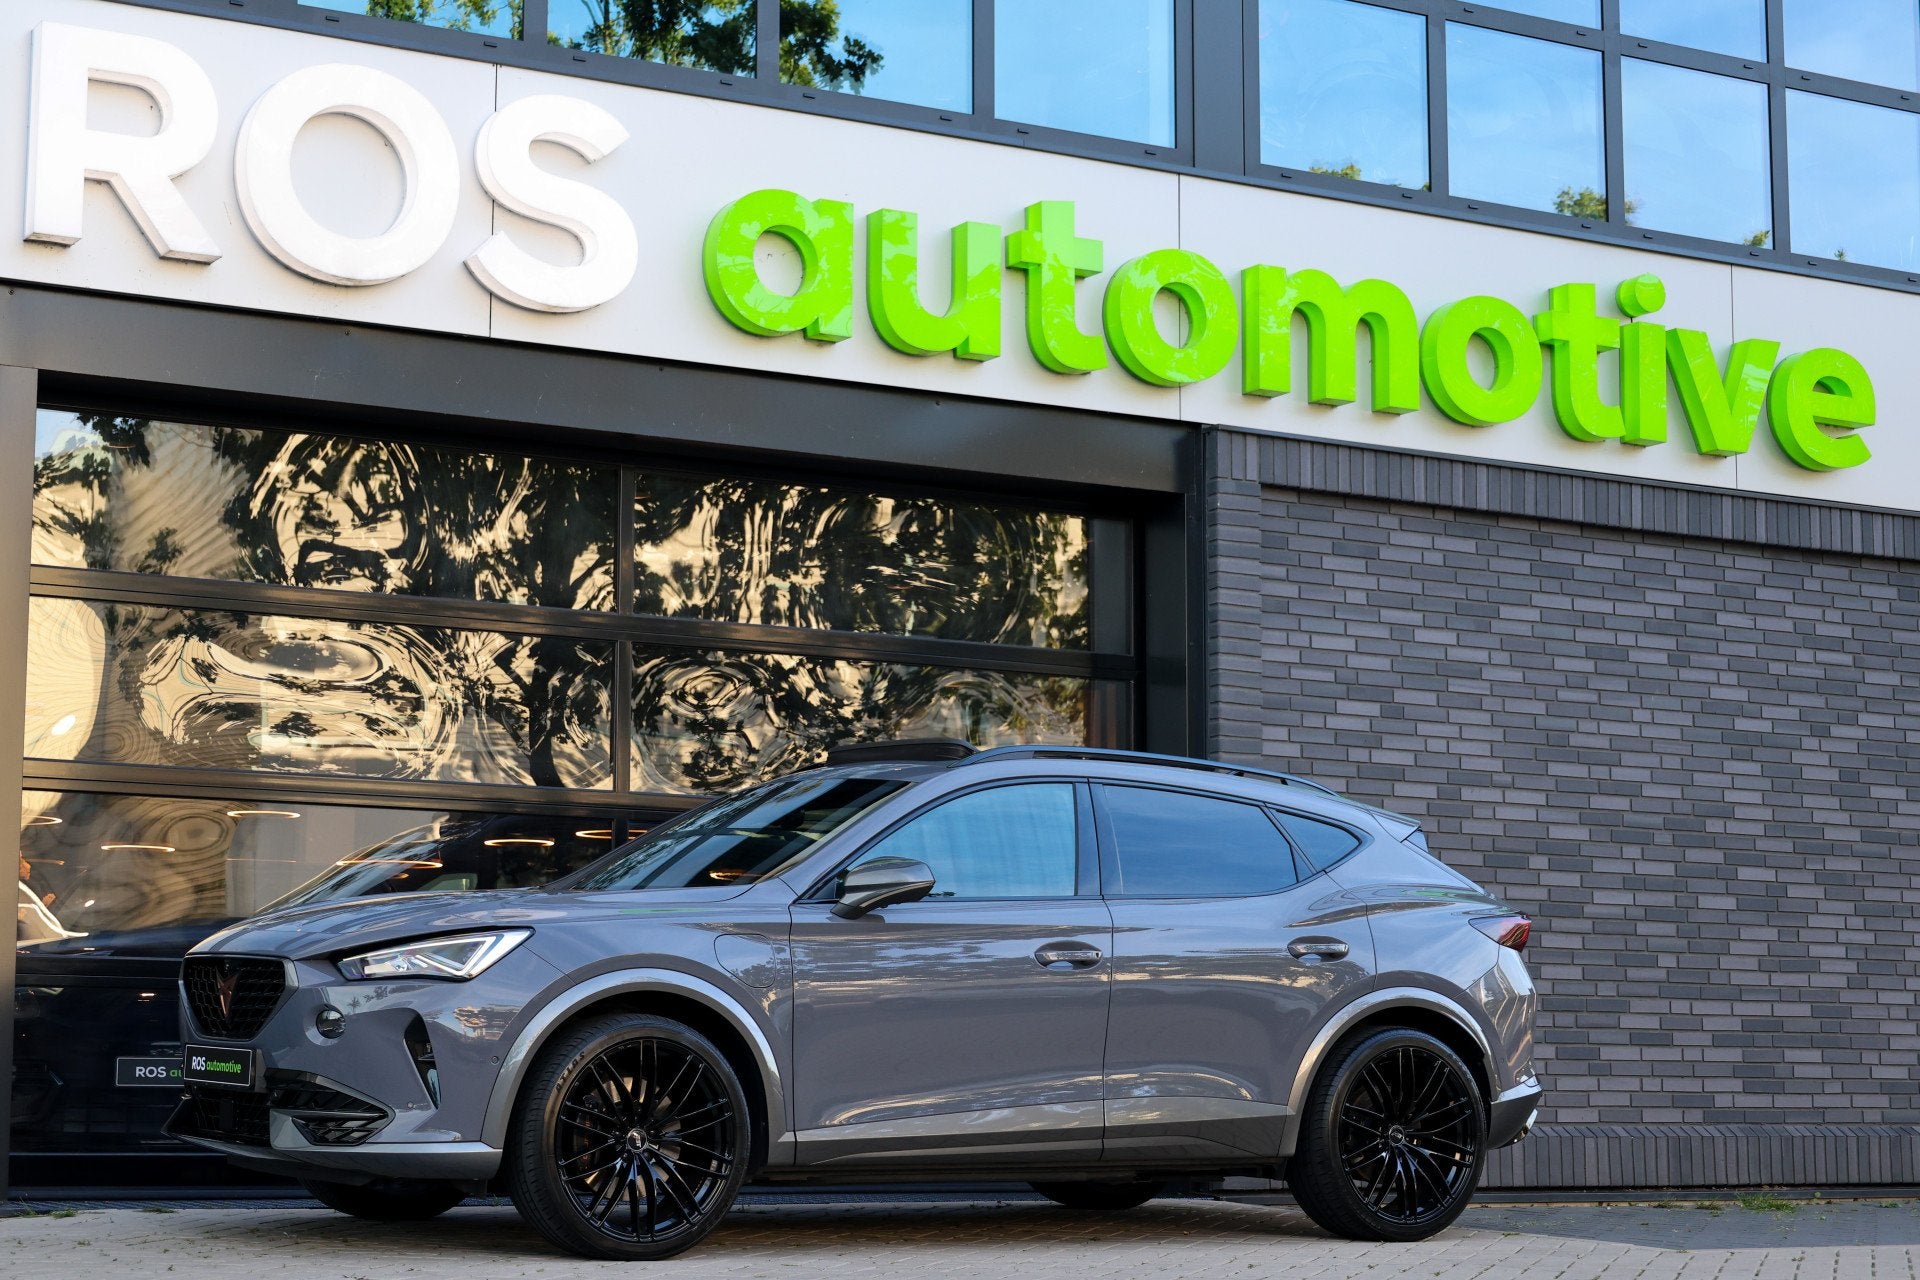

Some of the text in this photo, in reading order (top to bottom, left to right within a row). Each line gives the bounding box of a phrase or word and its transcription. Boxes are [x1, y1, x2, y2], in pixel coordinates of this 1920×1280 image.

[23, 20, 1876, 472] ROS automotive
[135, 1066, 167, 1078] ROS
[191, 1056, 242, 1073] ROS automotive
